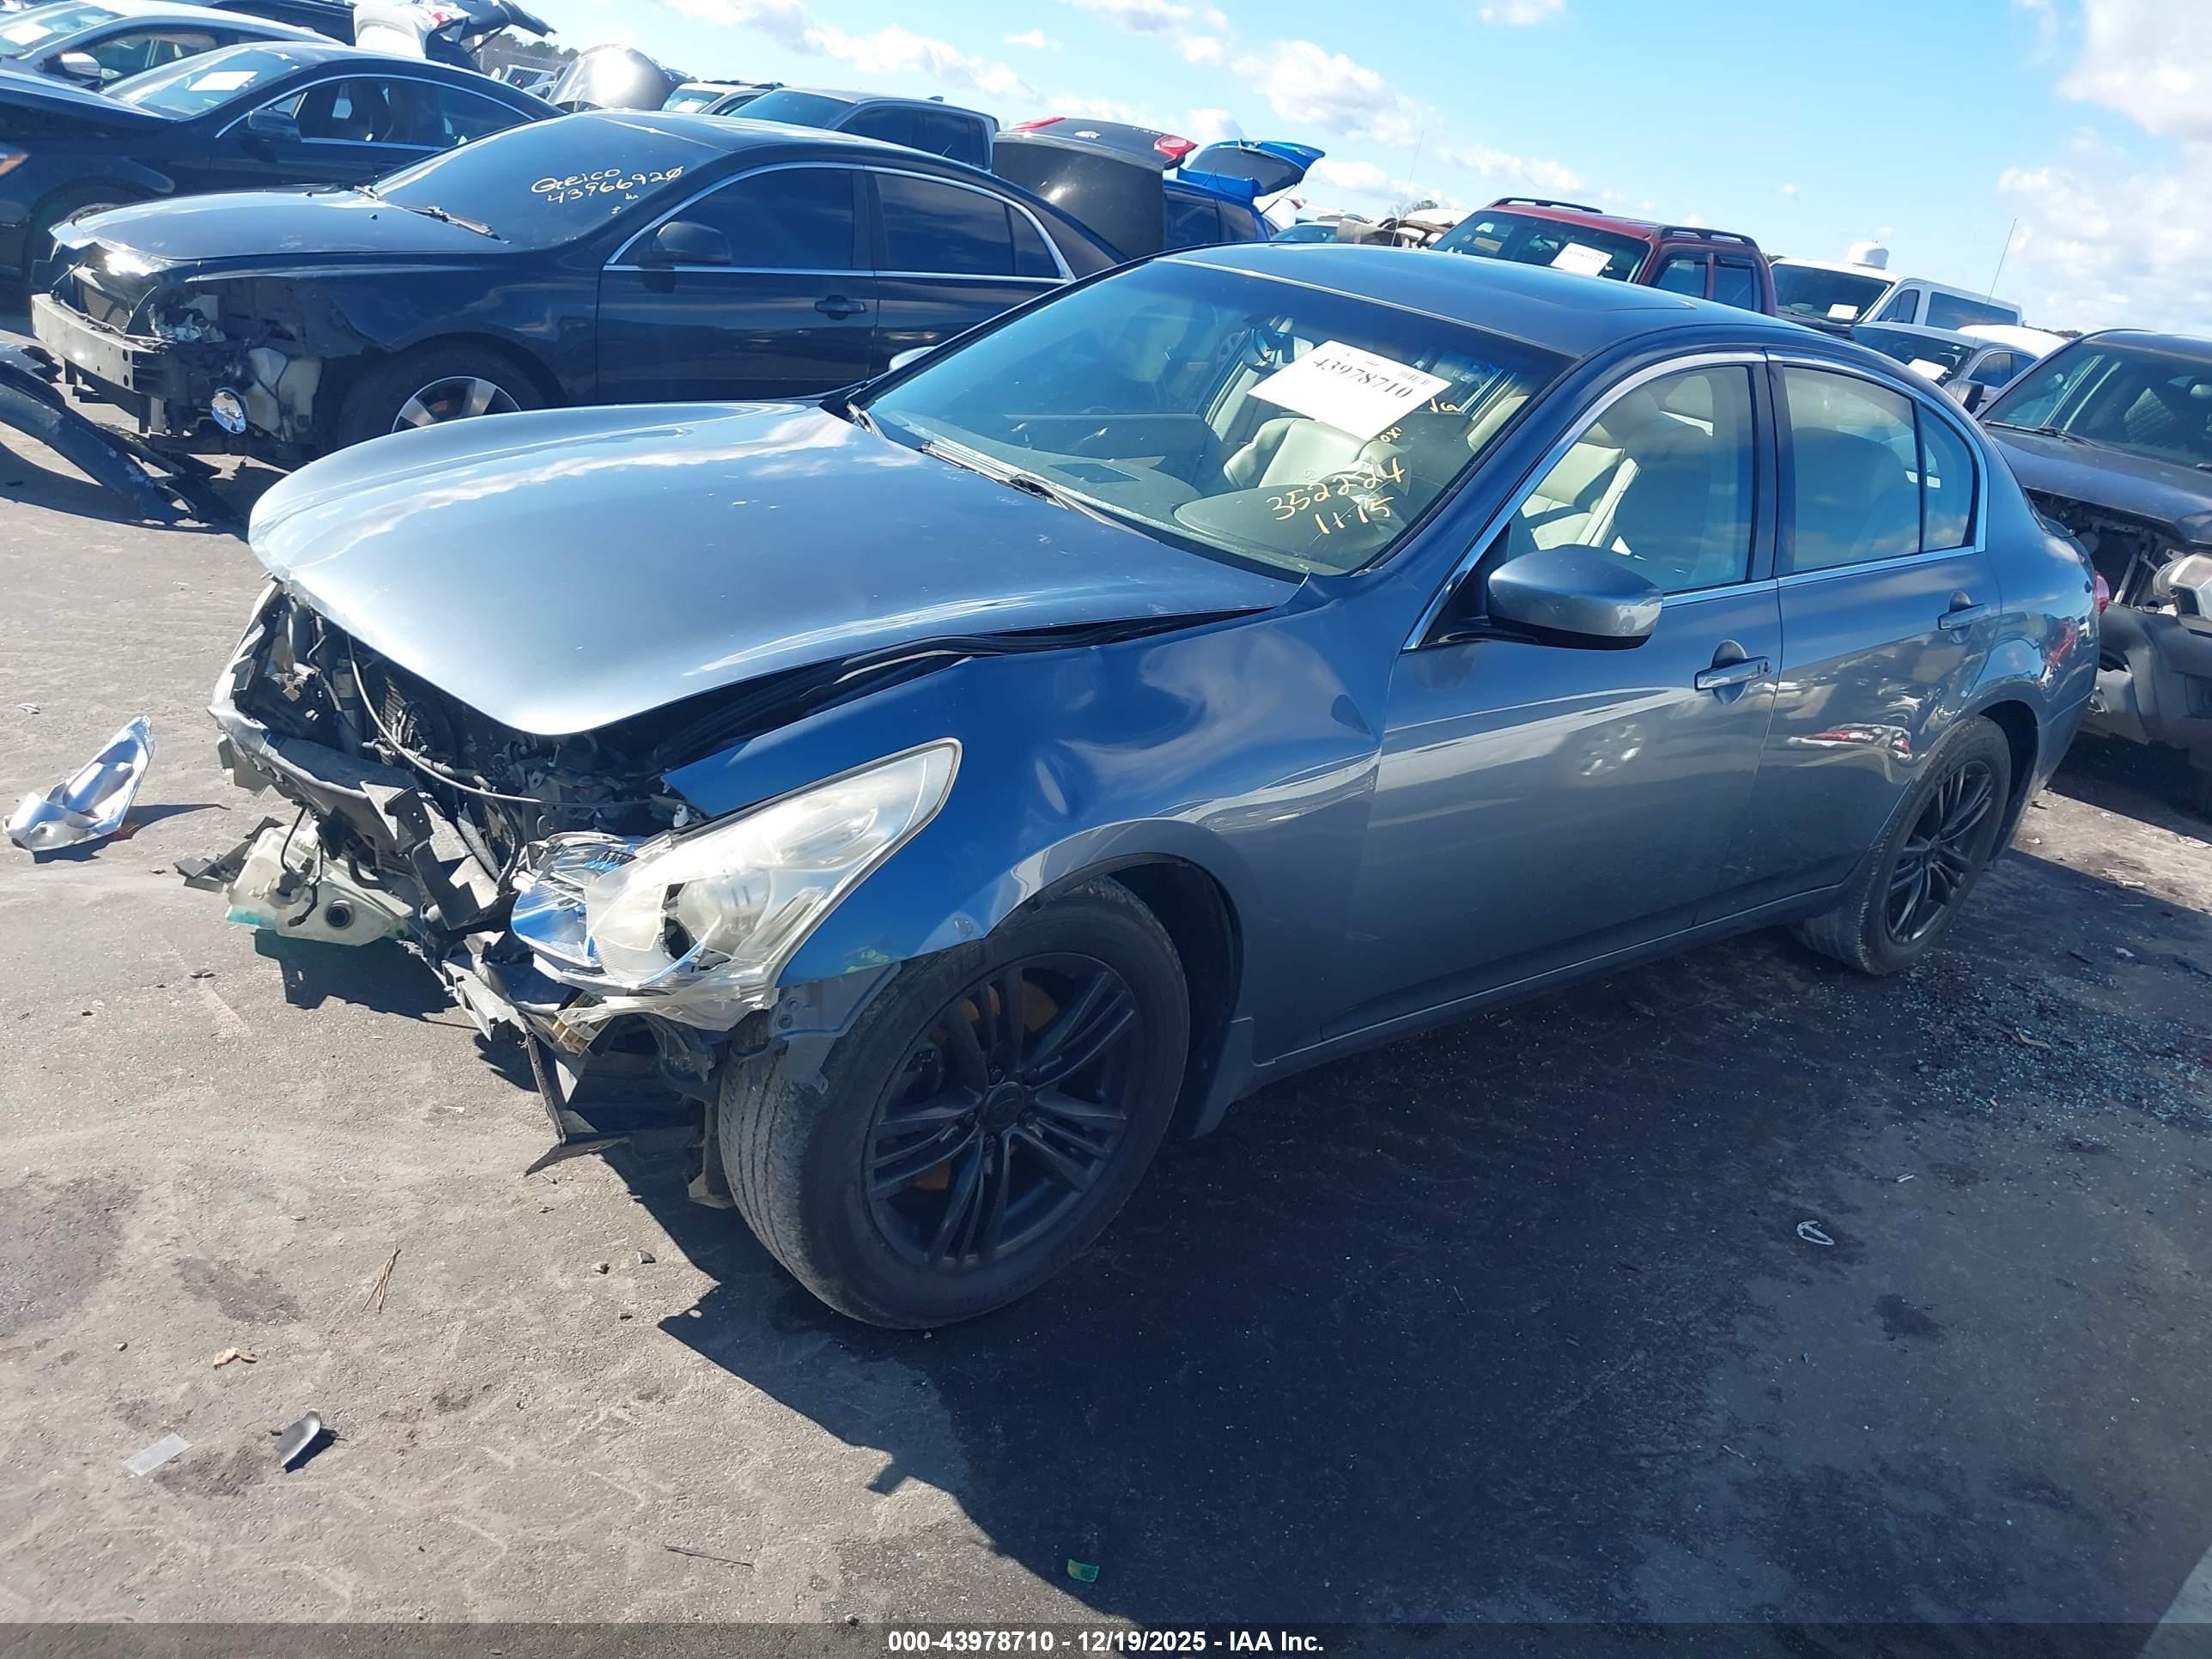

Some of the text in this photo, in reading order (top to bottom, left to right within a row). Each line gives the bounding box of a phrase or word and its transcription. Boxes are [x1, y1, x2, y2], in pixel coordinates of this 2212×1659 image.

[546, 165, 684, 204] 43966920
[1313, 357, 1413, 398] 43978710
[1265, 457, 1407, 520] 352224
